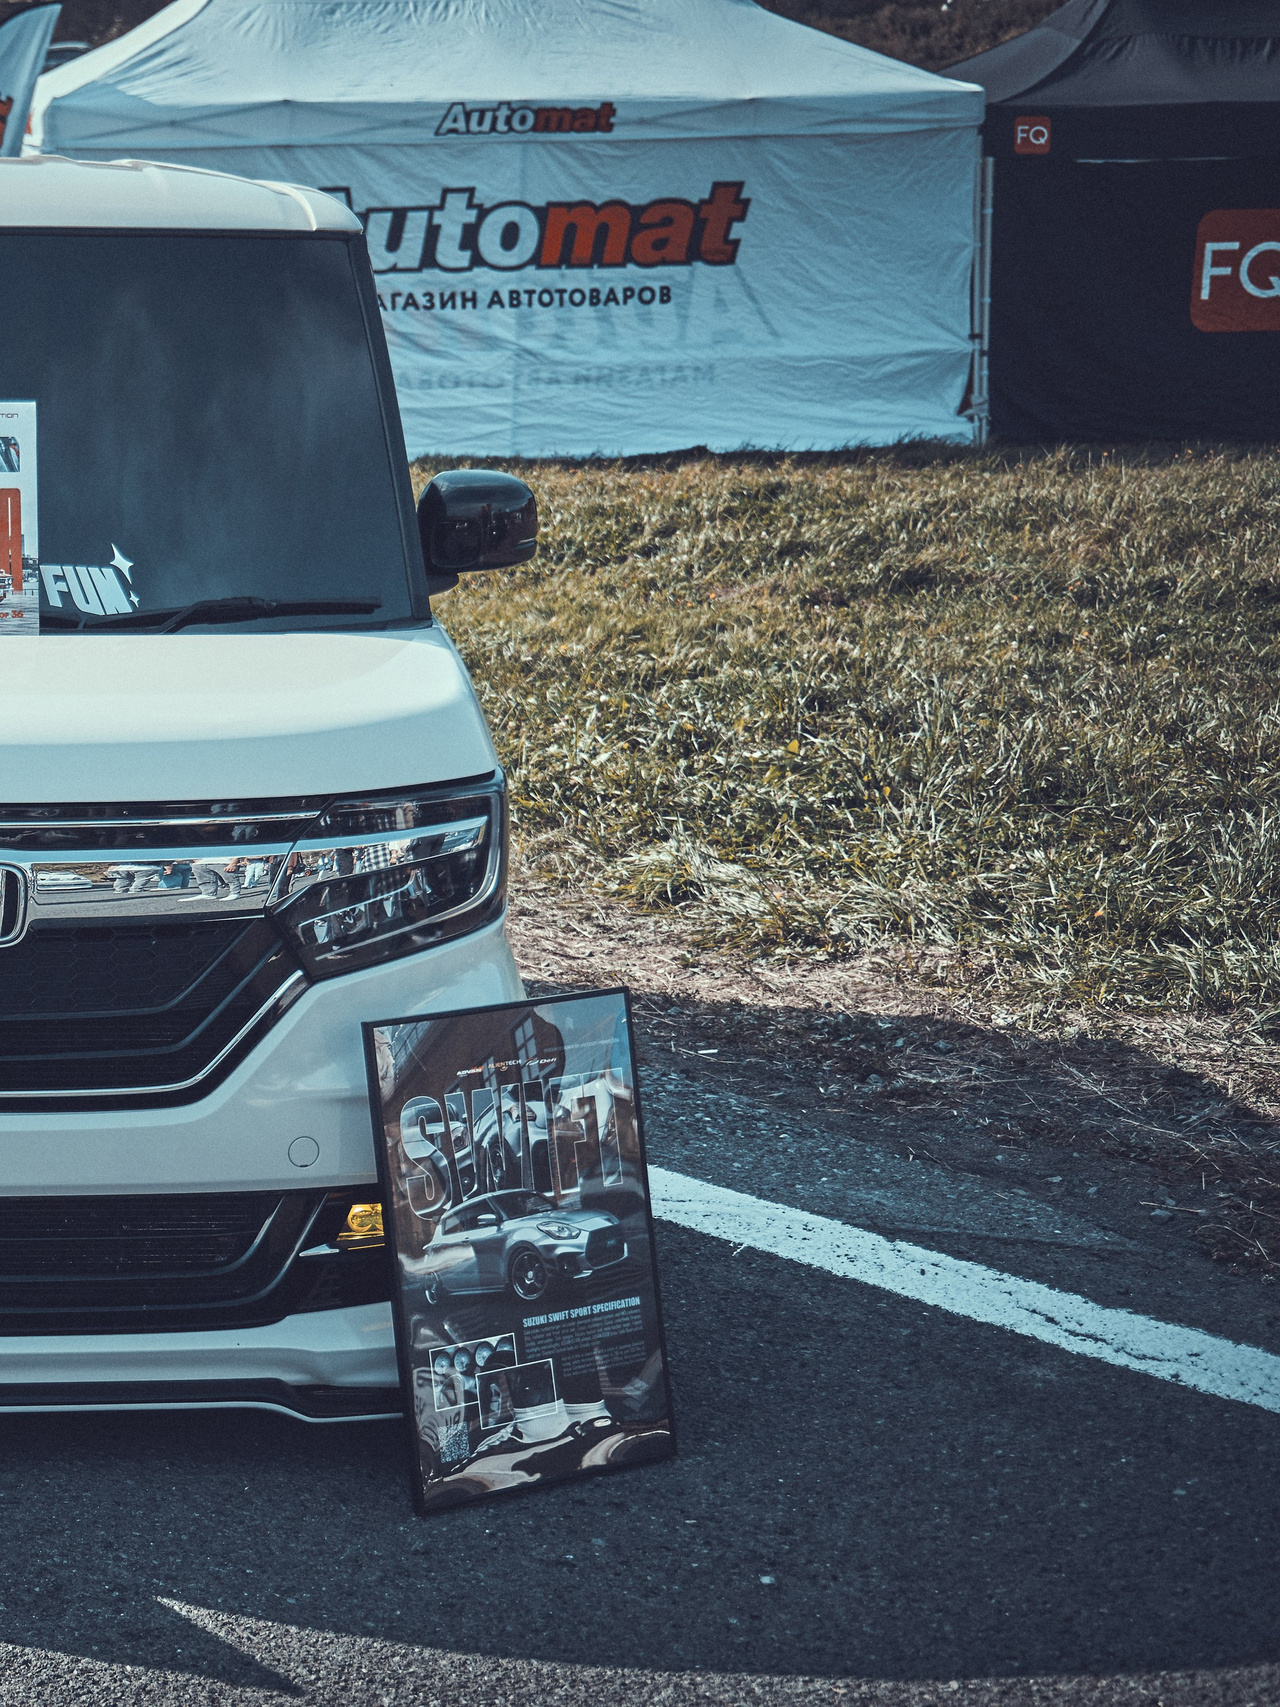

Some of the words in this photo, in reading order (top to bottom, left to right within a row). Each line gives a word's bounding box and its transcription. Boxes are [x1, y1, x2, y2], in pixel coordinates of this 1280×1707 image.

[434, 101, 617, 136] Automat
[1017, 126, 1048, 145] FQ
[487, 286, 672, 310] АВТОТОВАРОВ
[39, 565, 133, 616] FUN
[400, 1068, 623, 1220] SWIFT
[522, 1315, 548, 1328] SUZUKI
[548, 1310, 569, 1323] SWIFT
[570, 1305, 592, 1319] SPORT
[592, 1296, 641, 1314] SPECIFICATION
